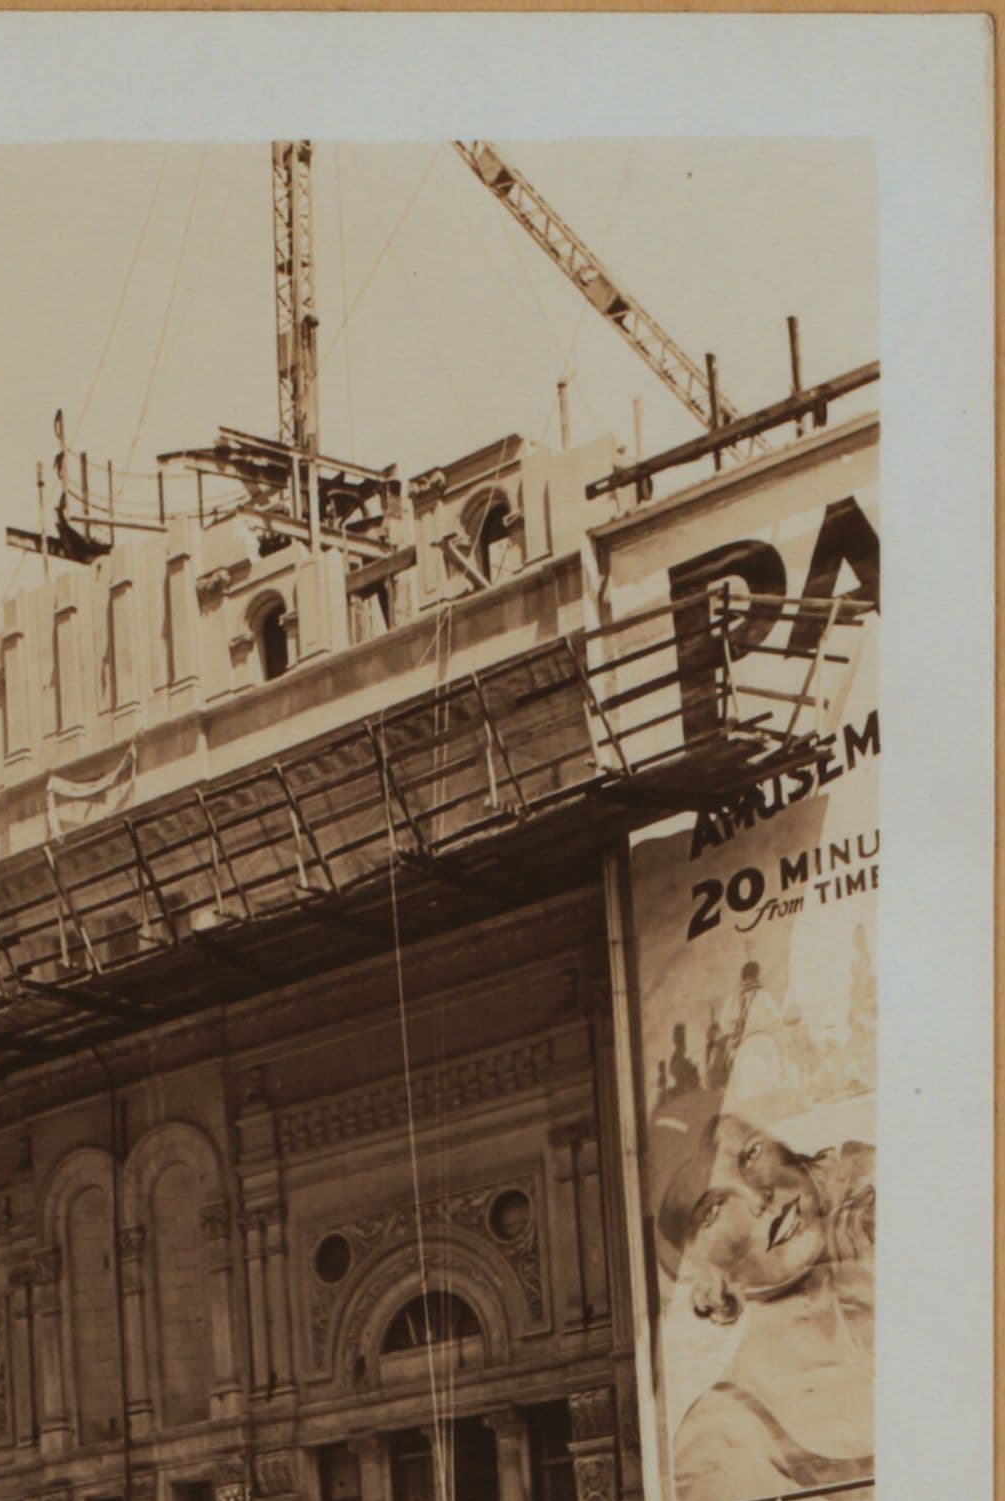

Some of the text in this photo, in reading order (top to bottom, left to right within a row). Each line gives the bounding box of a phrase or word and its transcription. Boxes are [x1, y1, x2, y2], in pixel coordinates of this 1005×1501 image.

[687, 829, 880, 941] 20 MINU
[735, 895, 804, 933] from
